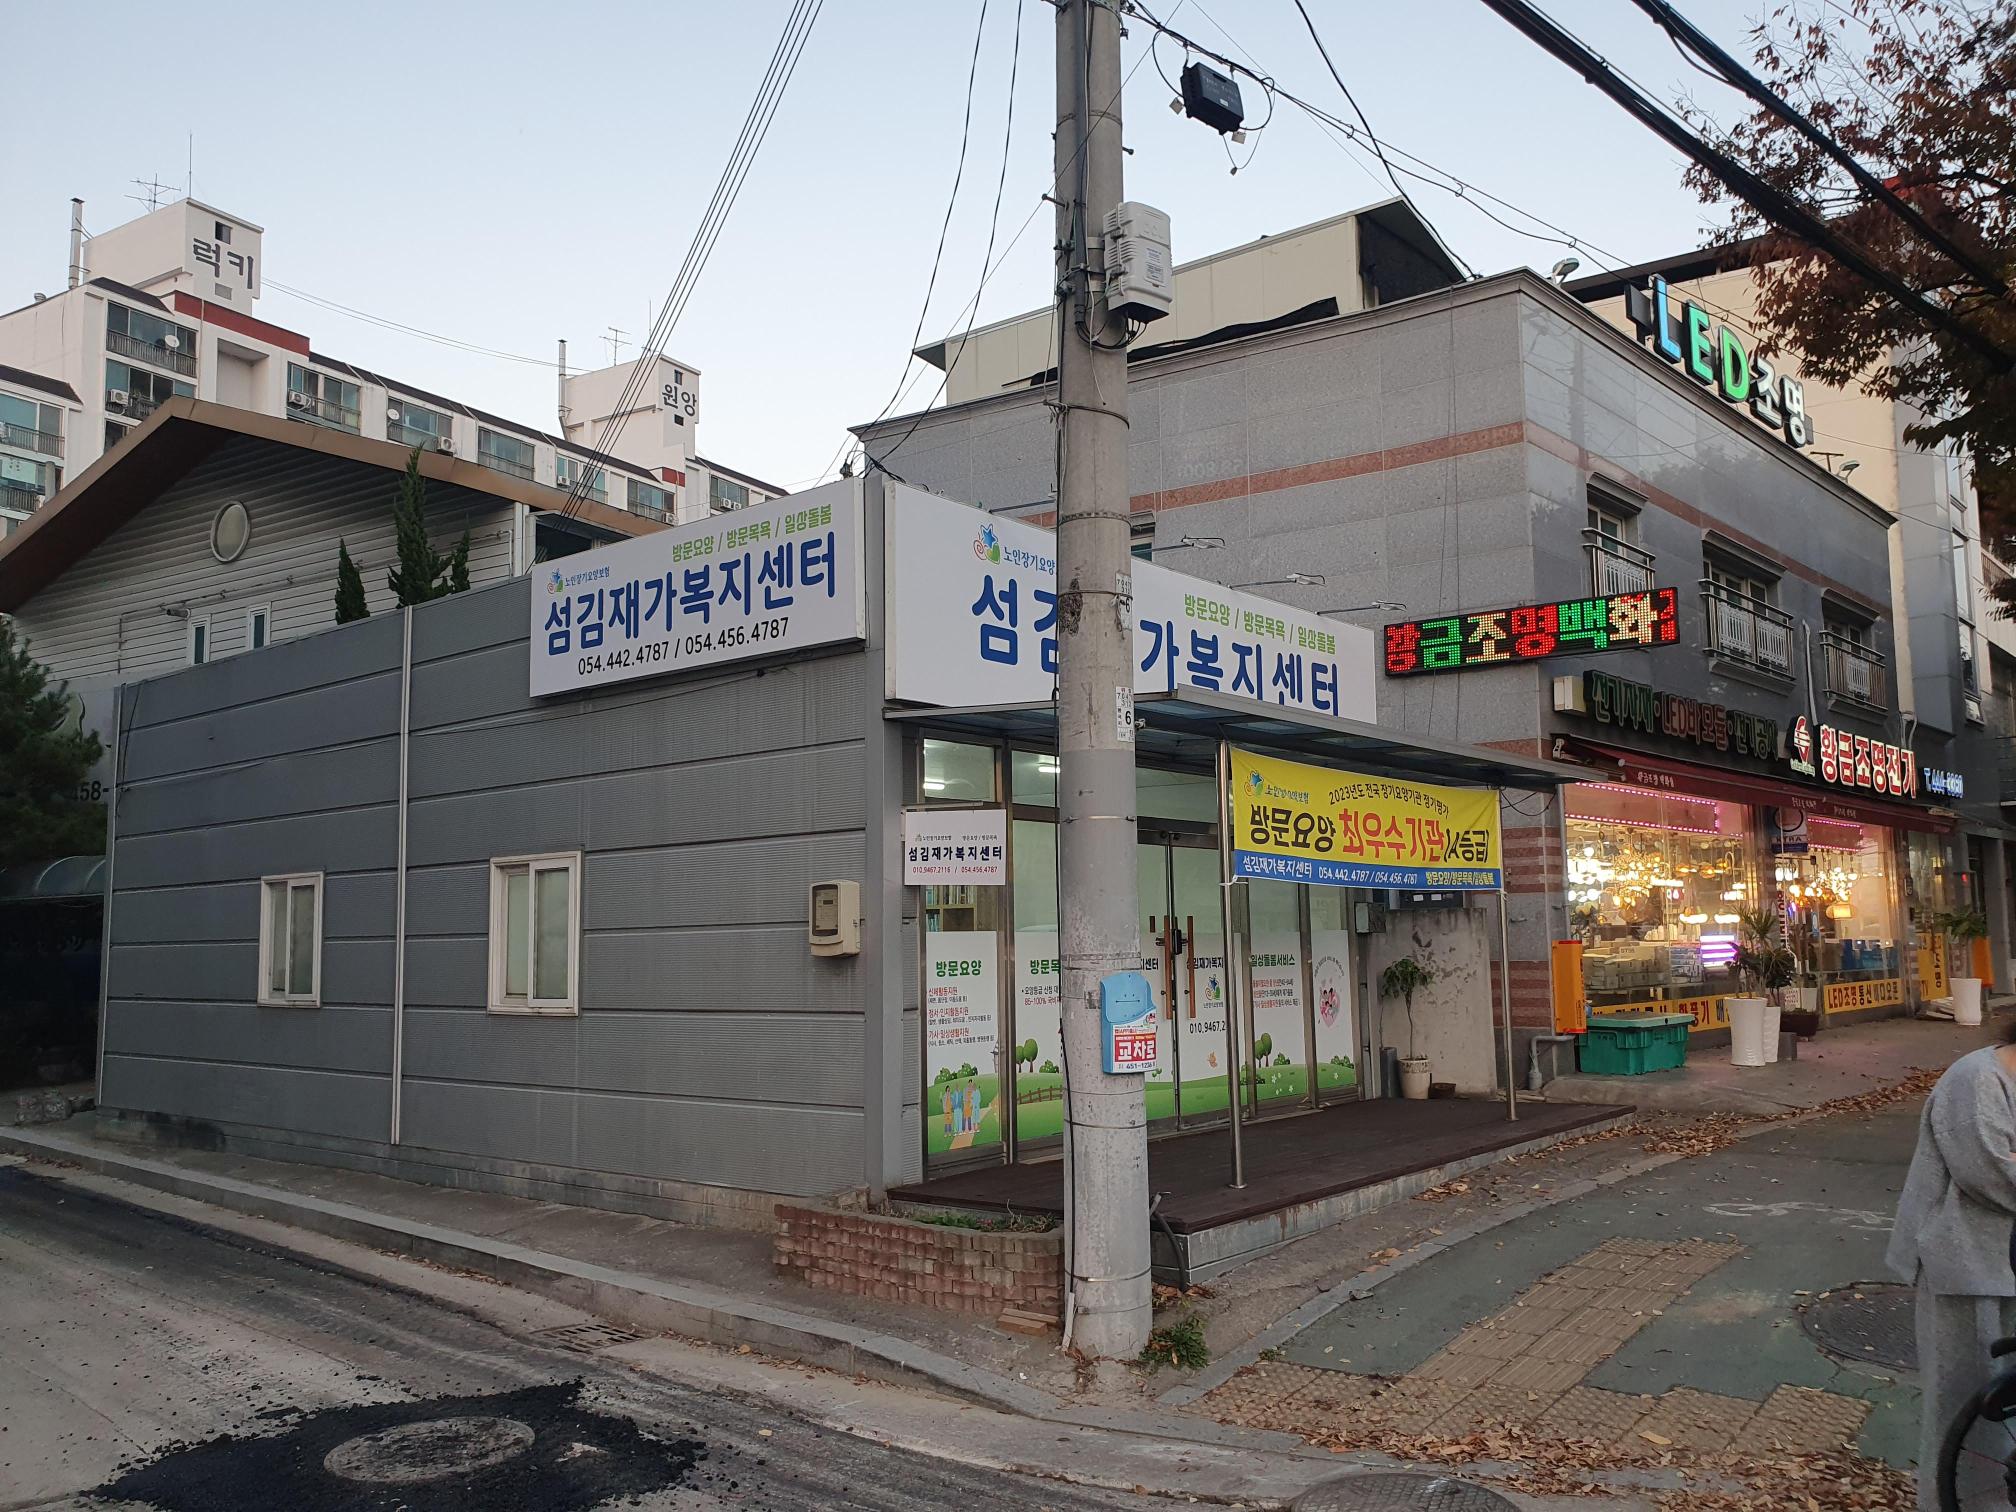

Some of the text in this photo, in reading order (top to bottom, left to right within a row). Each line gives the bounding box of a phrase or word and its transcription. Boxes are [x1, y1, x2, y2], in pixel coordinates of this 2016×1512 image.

[193, 237, 254, 290] 럭키
[662, 384, 698, 417] 원앙
[672, 535, 714, 563] 방문요양
[726, 519, 772, 549] 방문목욕
[785, 503, 832, 535] 일상돌봄
[565, 566, 610, 587] 노인장기요양보험
[544, 531, 835, 656] 섬김재가복지센터
[1184, 593, 1230, 627] 방문요양
[1243, 610, 1286, 643] 방문목욕
[1297, 625, 1337, 655] 일상돌봄
[578, 640, 669, 675] 054.442.4787
[685, 616, 789, 655] 054.456.4787
[1125, 710, 1132, 726] 6
[1820, 724, 1916, 799] 황금조명전기
[1328, 783, 1450, 820] 2023년도 전국 장기요양기관 정기평가
[1250, 803, 1336, 853] 방문요양
[908, 845, 1002, 862] 섬김재가복지센터
[961, 865, 998, 874] 054.456.4787
[1242, 855, 1312, 879] 섬김재가복지센터
[1318, 866, 1369, 882] 054.442.4787
[1375, 870, 1418, 885] 054.456.4787
[936, 959, 982, 977] 방문요양
[1250, 954, 1296, 967] 일상돌봄서비스
[1118, 1040, 1155, 1061] 교차로
